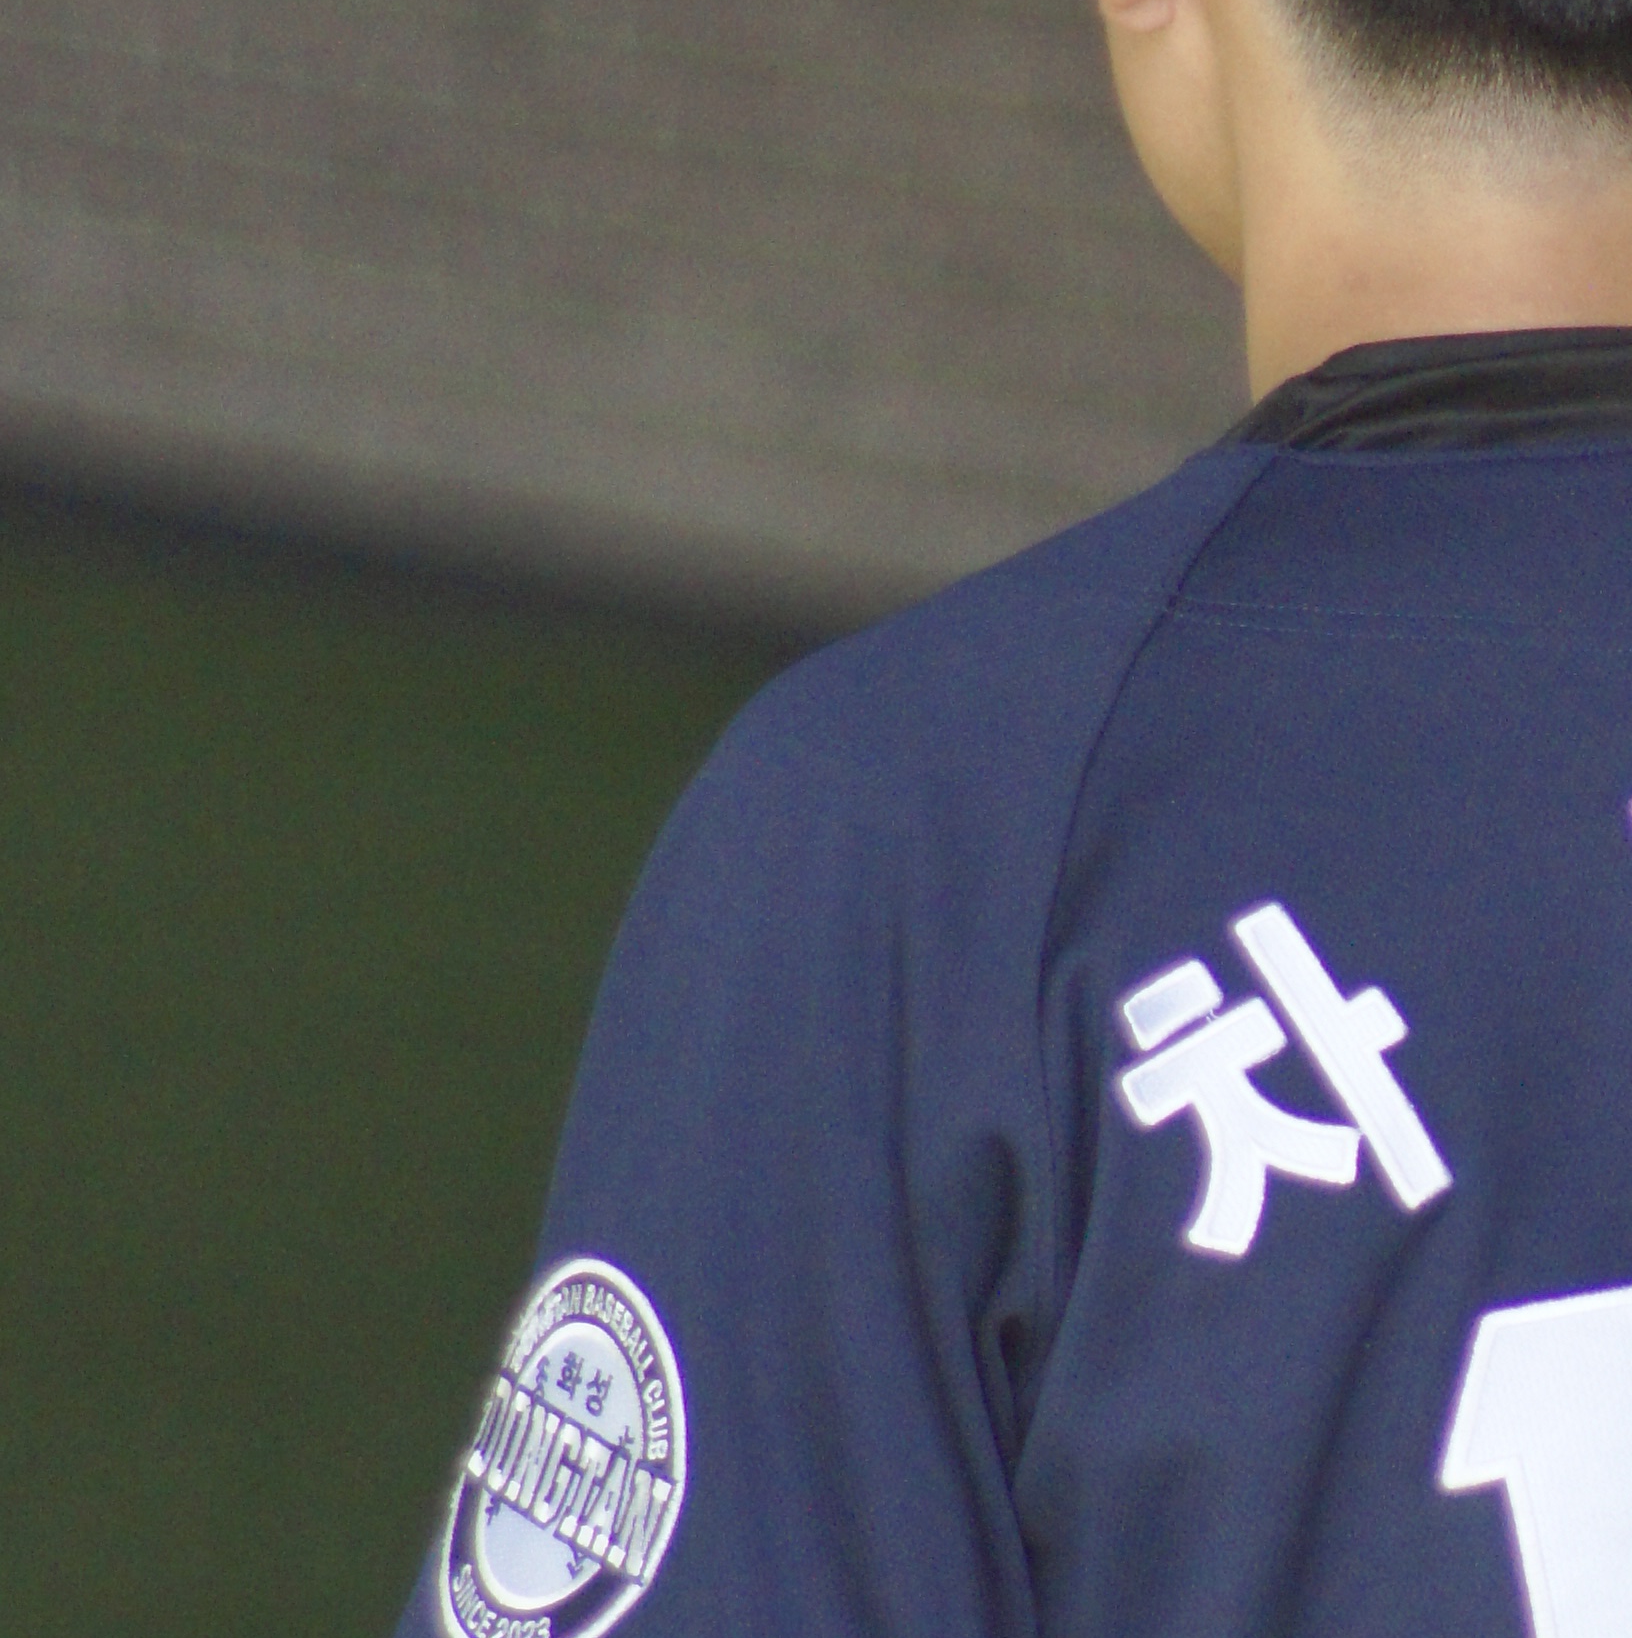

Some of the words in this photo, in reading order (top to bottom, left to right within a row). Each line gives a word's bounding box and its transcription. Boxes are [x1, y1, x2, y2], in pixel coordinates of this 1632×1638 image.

[556, 1351, 614, 1418] 화성
[583, 1283, 654, 1384] BASEBALL
[641, 1379, 669, 1461] CLUB
[467, 1376, 672, 1577] DONGTAN
